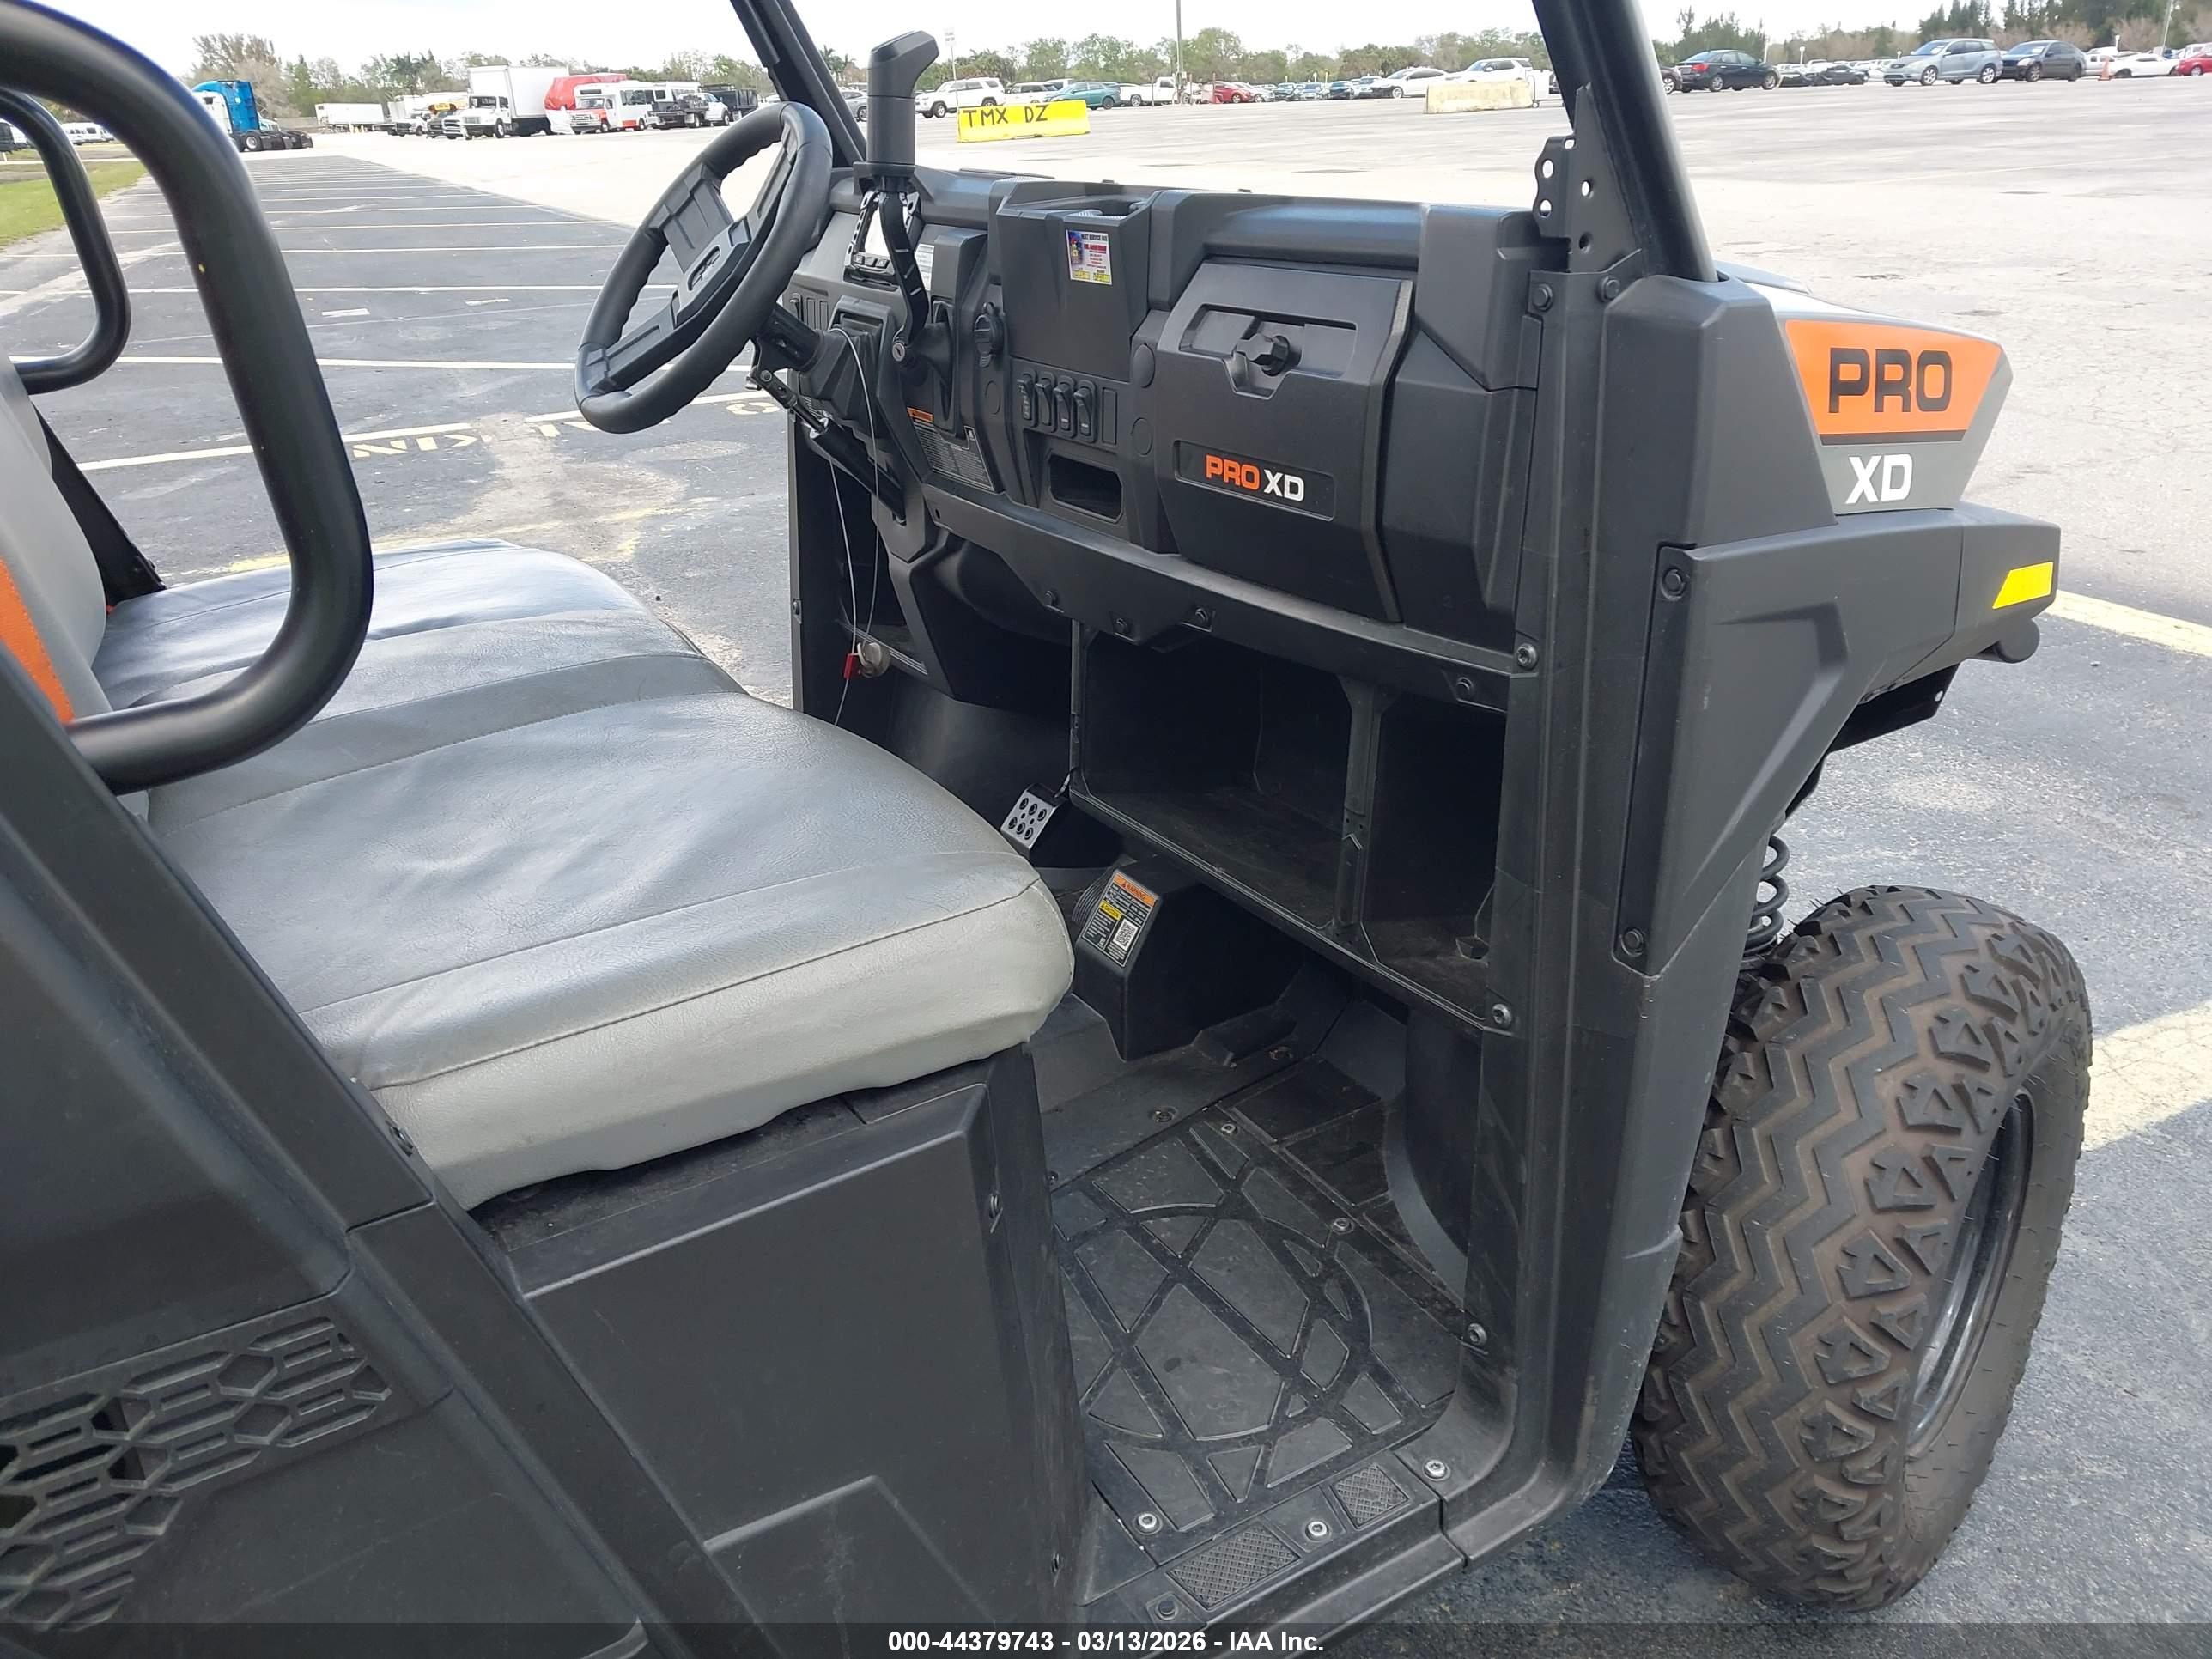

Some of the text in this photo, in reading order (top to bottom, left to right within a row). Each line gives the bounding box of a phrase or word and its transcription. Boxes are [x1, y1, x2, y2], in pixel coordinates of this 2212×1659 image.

[962, 105, 1049, 128] TMX DZ
[1829, 348, 1952, 413] PRO
[1206, 454, 1304, 501] PRO XD
[1845, 453, 1914, 505] XD
